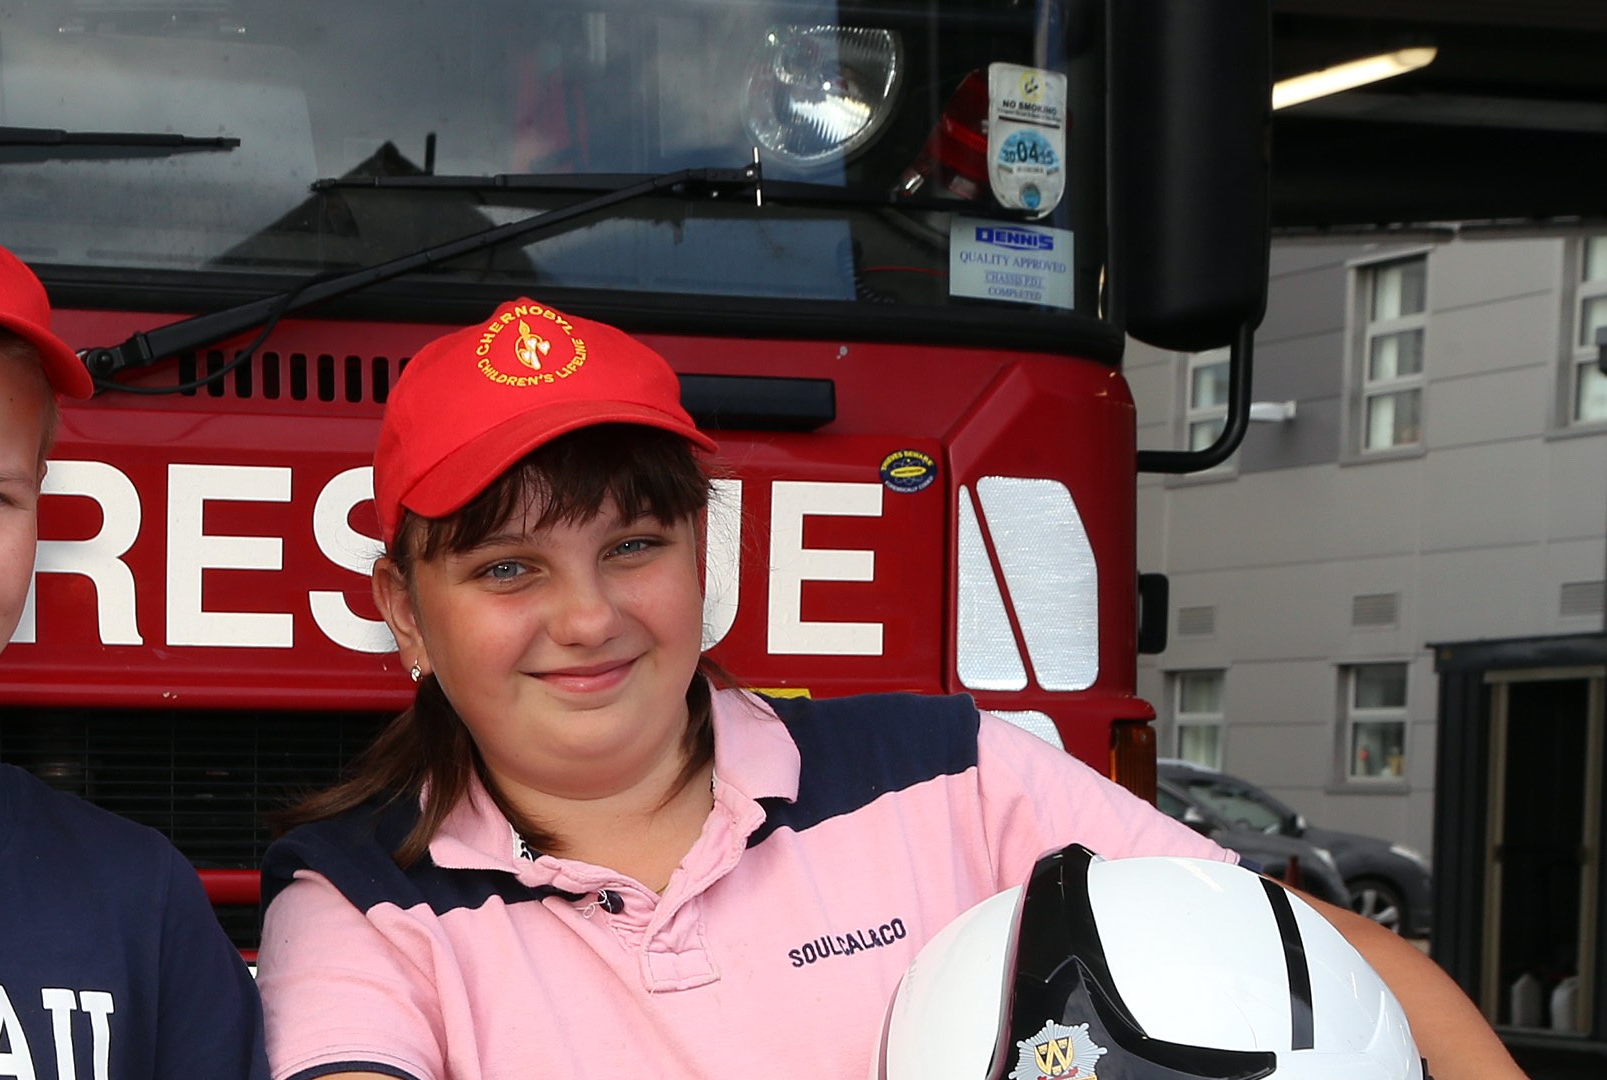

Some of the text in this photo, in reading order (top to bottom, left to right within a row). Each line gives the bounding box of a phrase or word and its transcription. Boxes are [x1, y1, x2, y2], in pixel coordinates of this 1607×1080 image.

[1002, 99, 1016, 109] NO
[1018, 101, 1057, 116] SMOKING
[1016, 140, 1039, 163] 04
[975, 226, 1054, 251] DENNIS
[959, 251, 1067, 274] QUALITY APPROVED
[988, 286, 1043, 301] COMPLETED
[475, 305, 574, 357] CHERNOBYL
[477, 337, 587, 387] CHILDREN'S LIFELINE
[7, 460, 884, 656] RESE
